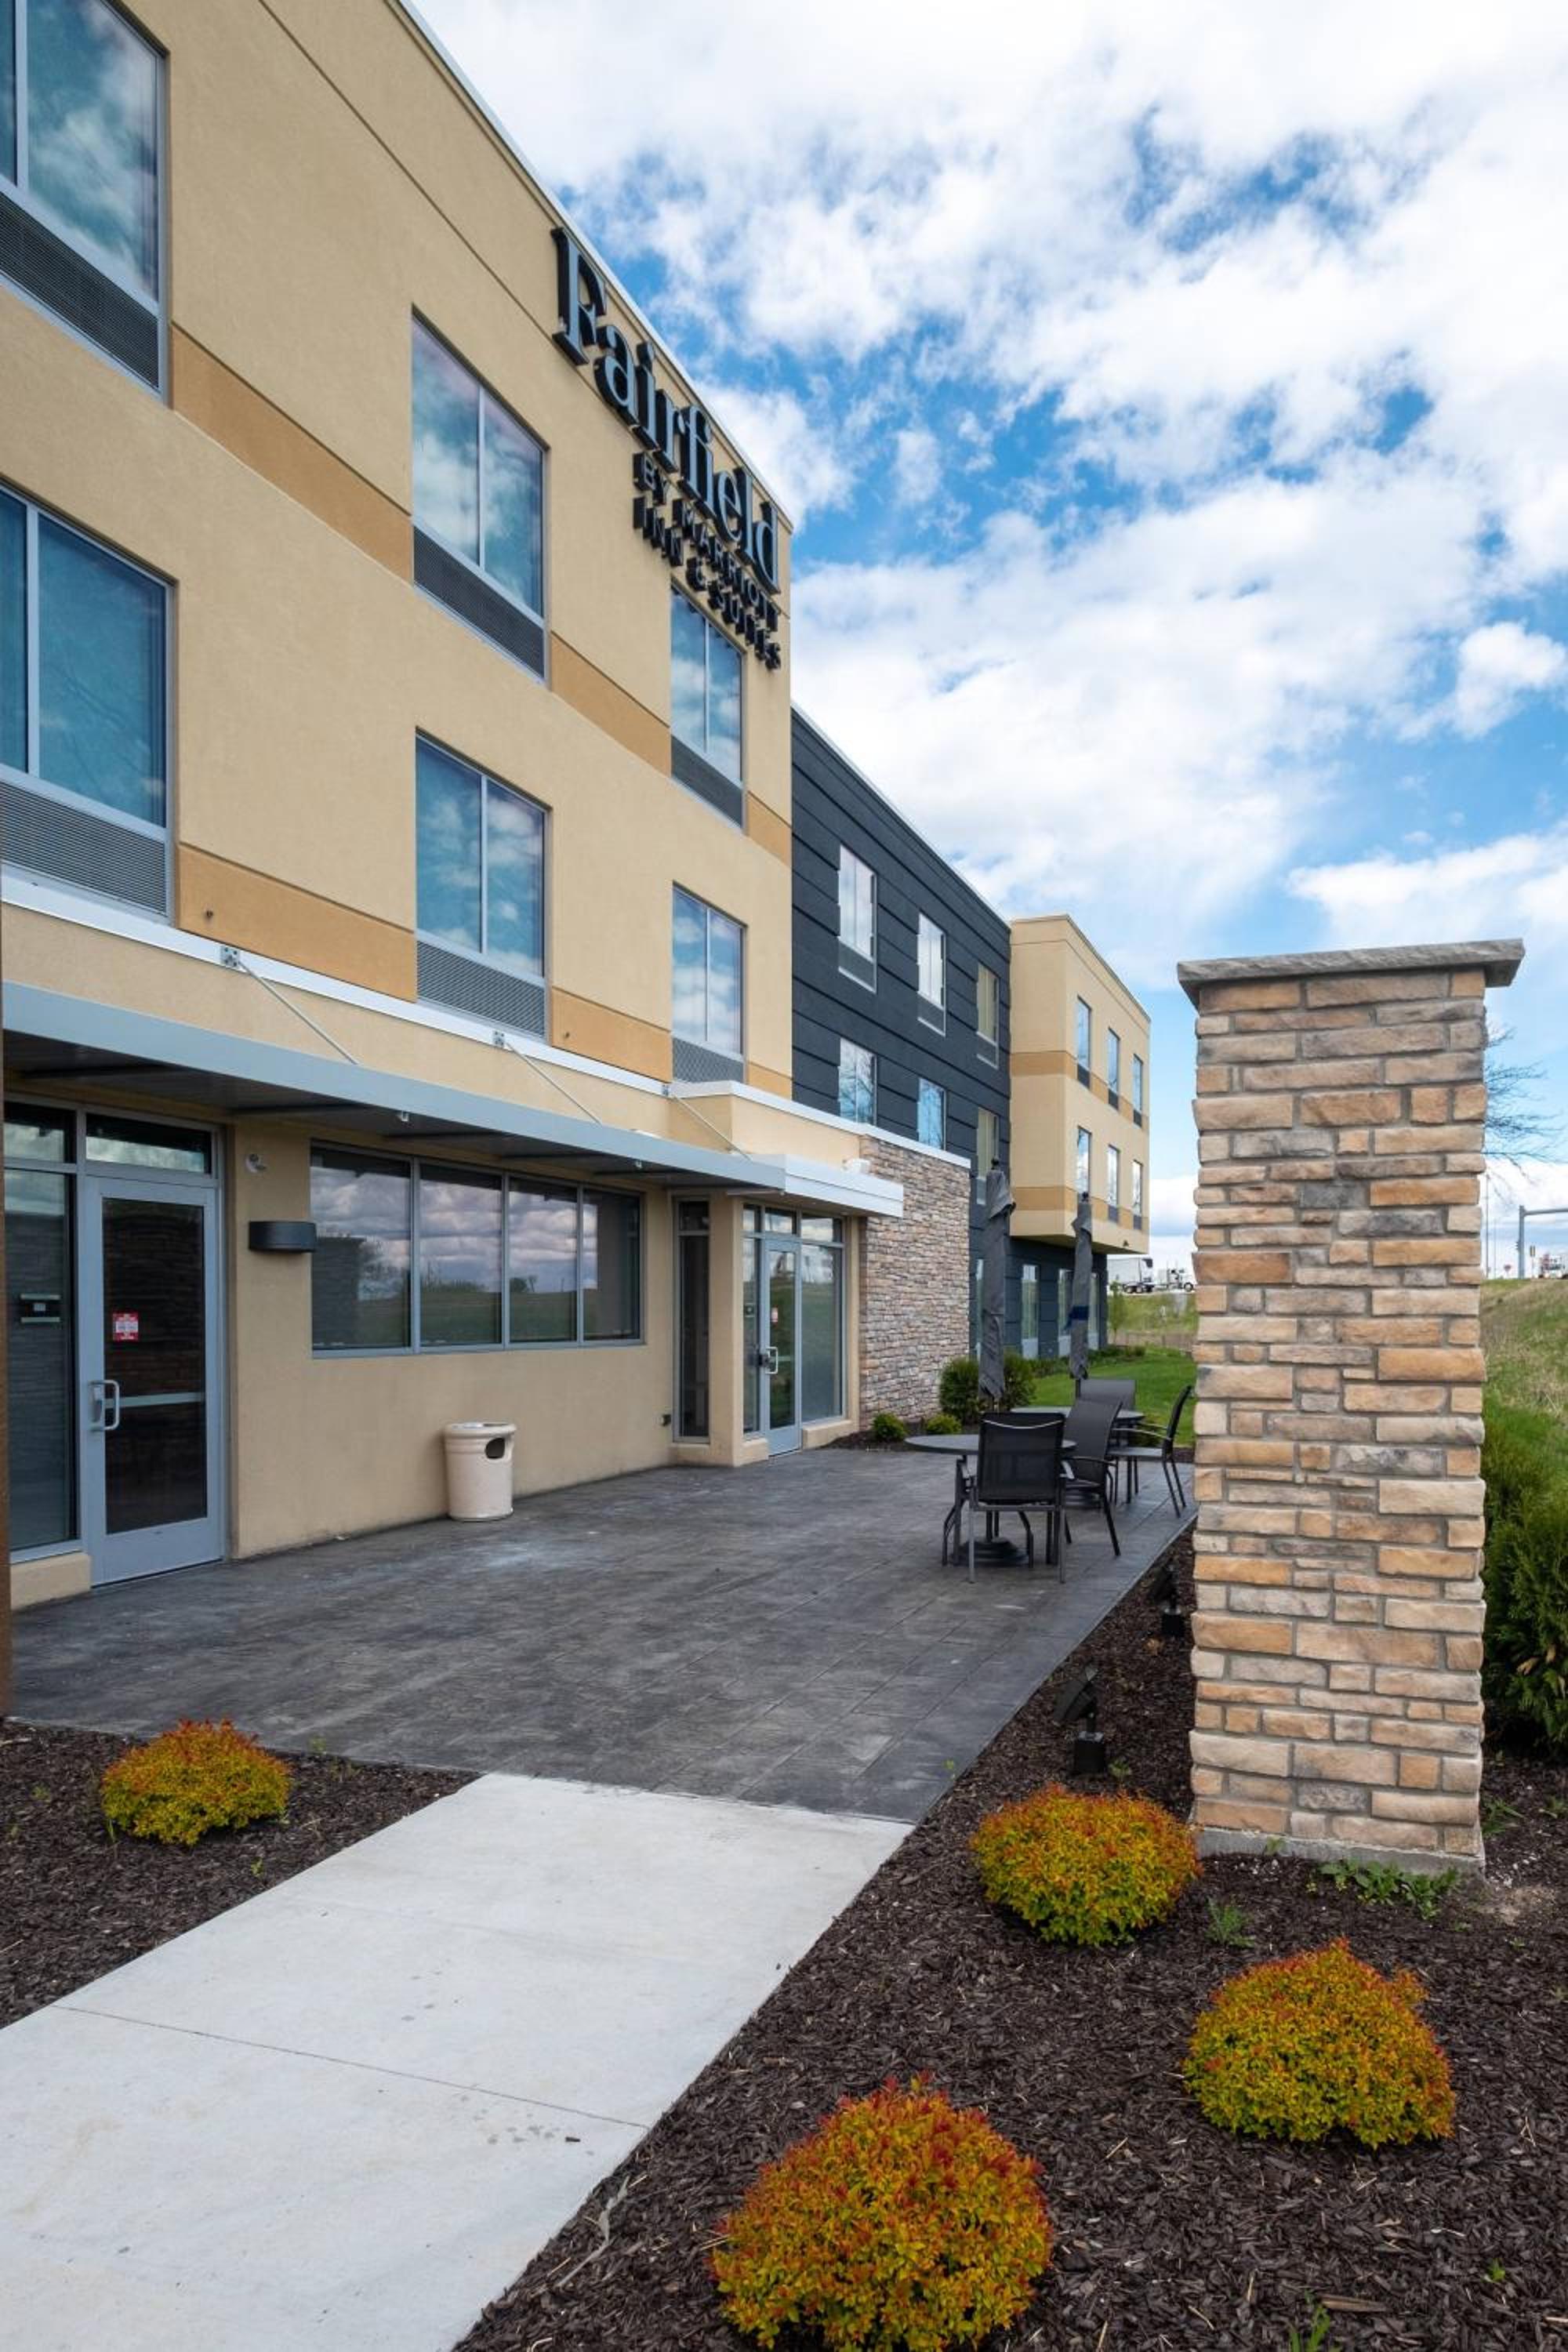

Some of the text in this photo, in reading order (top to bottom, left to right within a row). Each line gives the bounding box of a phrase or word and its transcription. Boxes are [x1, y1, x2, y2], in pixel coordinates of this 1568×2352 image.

[551, 227, 780, 594] Fairfield
[633, 452, 671, 506] BY
[633, 497, 684, 567] INN
